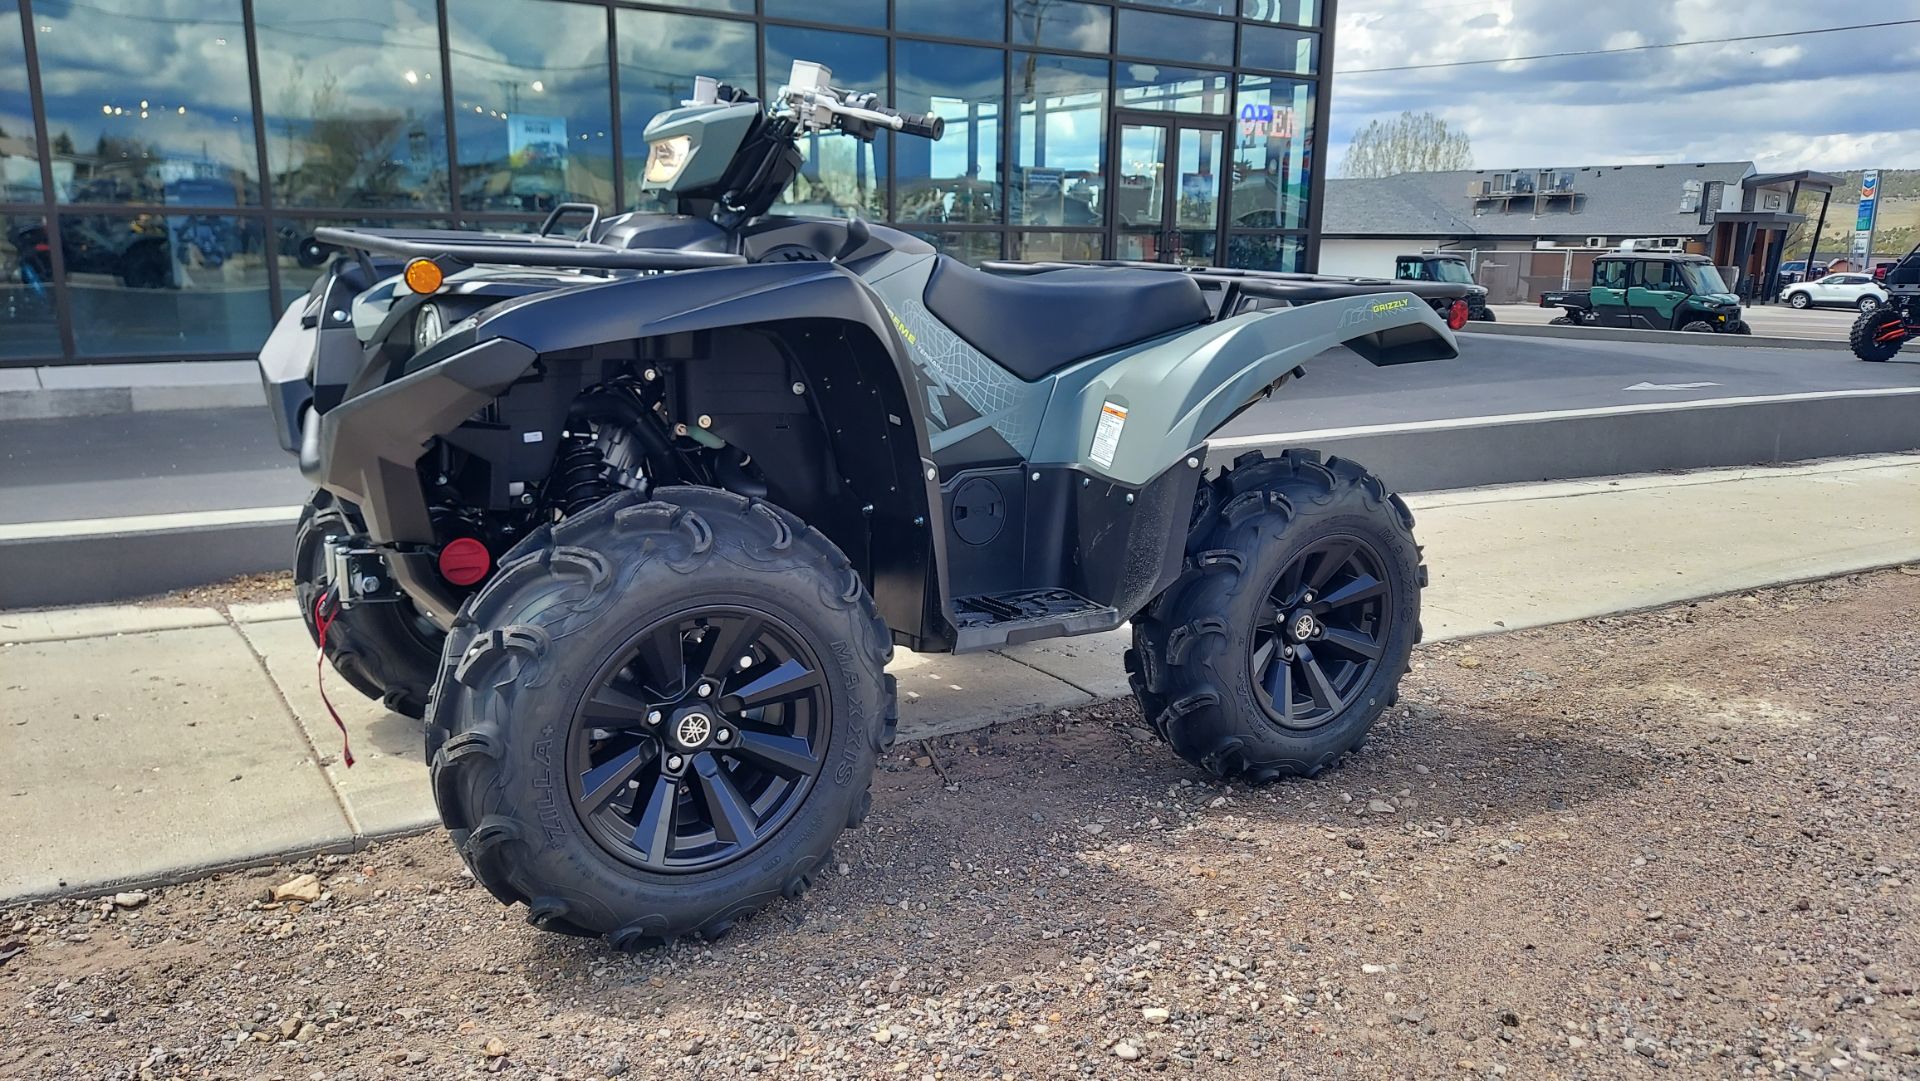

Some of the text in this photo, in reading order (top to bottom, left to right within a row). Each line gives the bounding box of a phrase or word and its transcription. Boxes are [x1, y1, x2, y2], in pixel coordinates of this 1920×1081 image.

[1241, 103, 1299, 138] OPEN
[1373, 298, 1408, 313] GRIZZLY
[830, 639, 864, 788] MAXXIS
